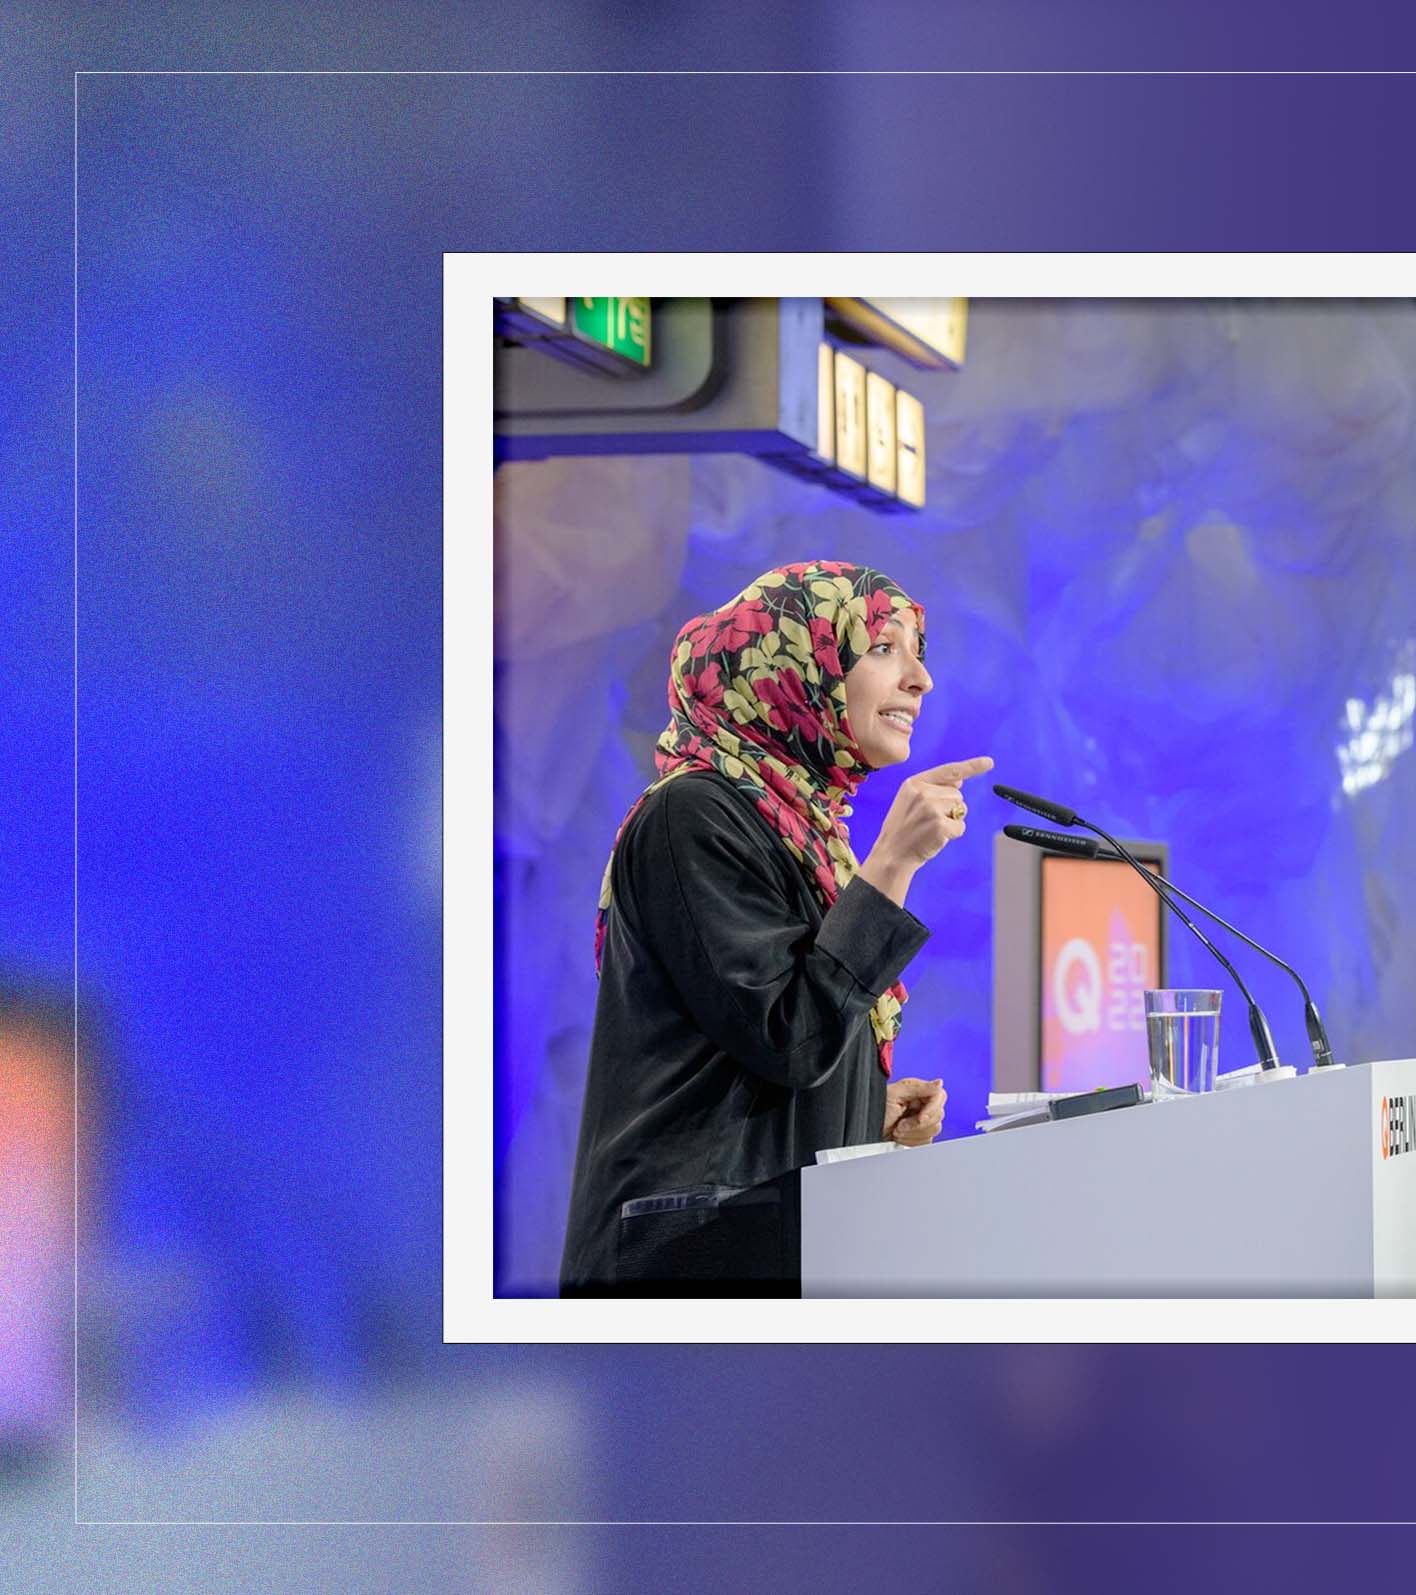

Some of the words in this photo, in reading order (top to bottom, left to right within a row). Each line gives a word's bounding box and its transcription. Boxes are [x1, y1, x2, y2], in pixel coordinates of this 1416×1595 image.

[1055, 938, 1102, 1034] Q
[1109, 943, 1147, 983] 20
[1389, 1095, 1416, 1156] BERLIN
